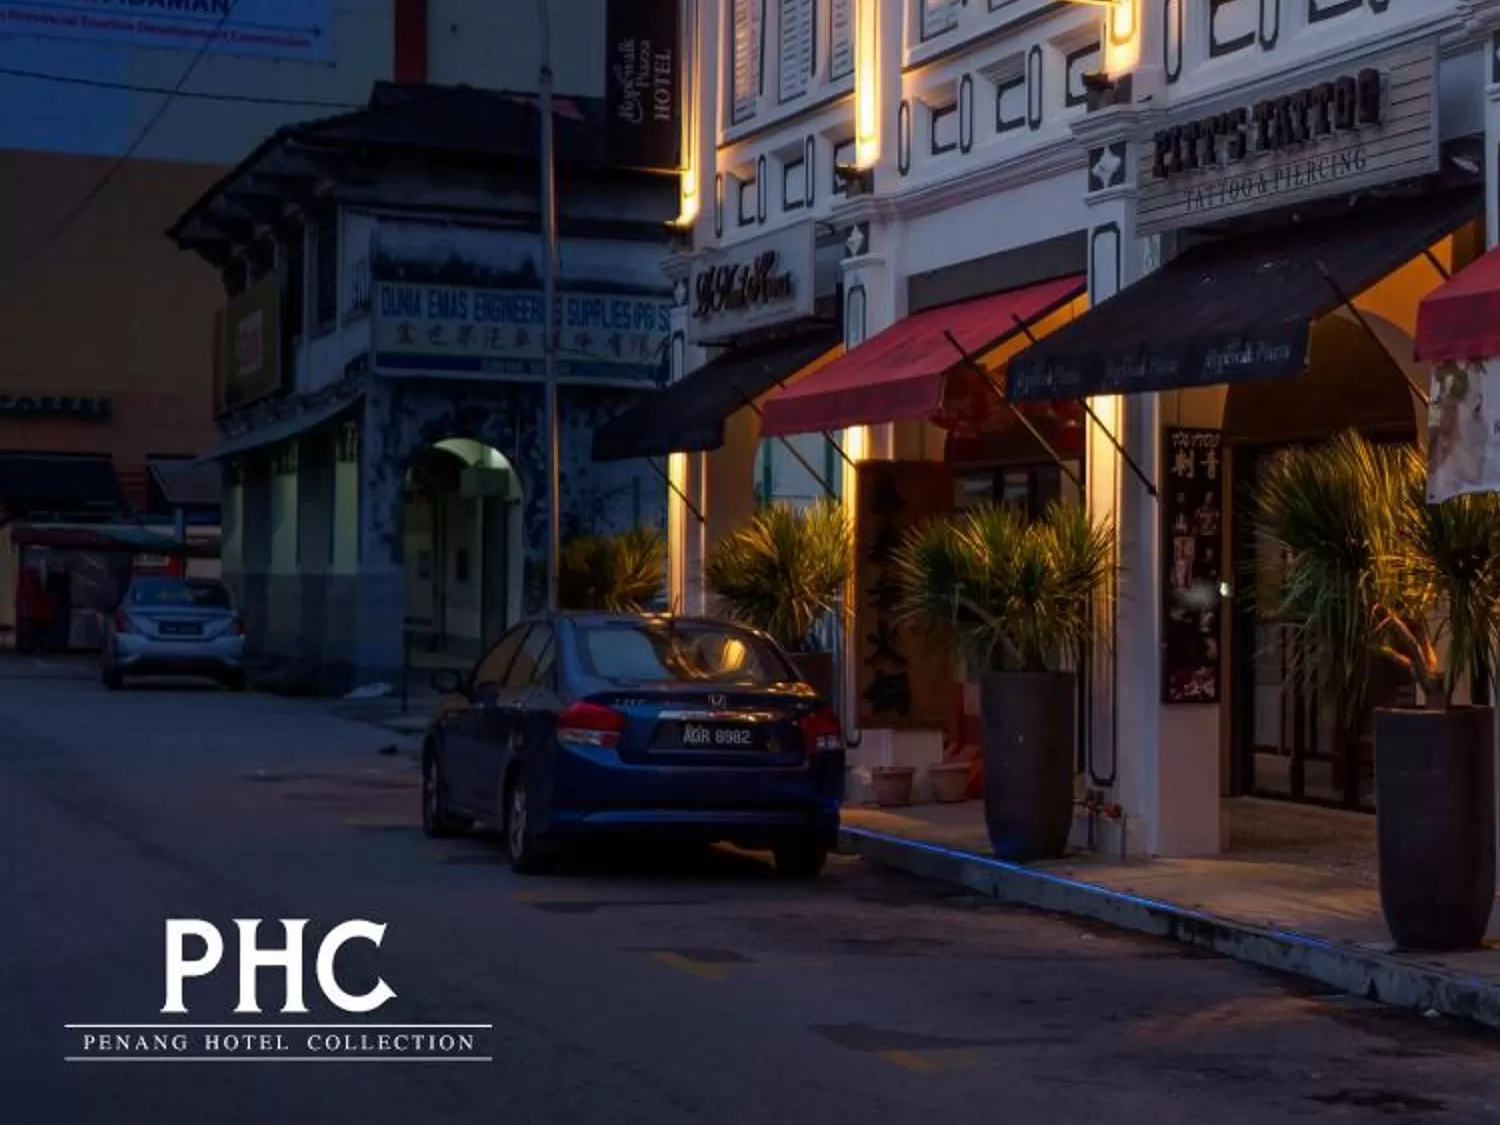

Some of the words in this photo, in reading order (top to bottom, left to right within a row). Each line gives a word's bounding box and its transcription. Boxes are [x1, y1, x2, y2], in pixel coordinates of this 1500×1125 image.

[653, 47, 671, 122] HOTEL
[1183, 176, 1254, 211] TATTOO
[1274, 147, 1367, 191] PIERCING
